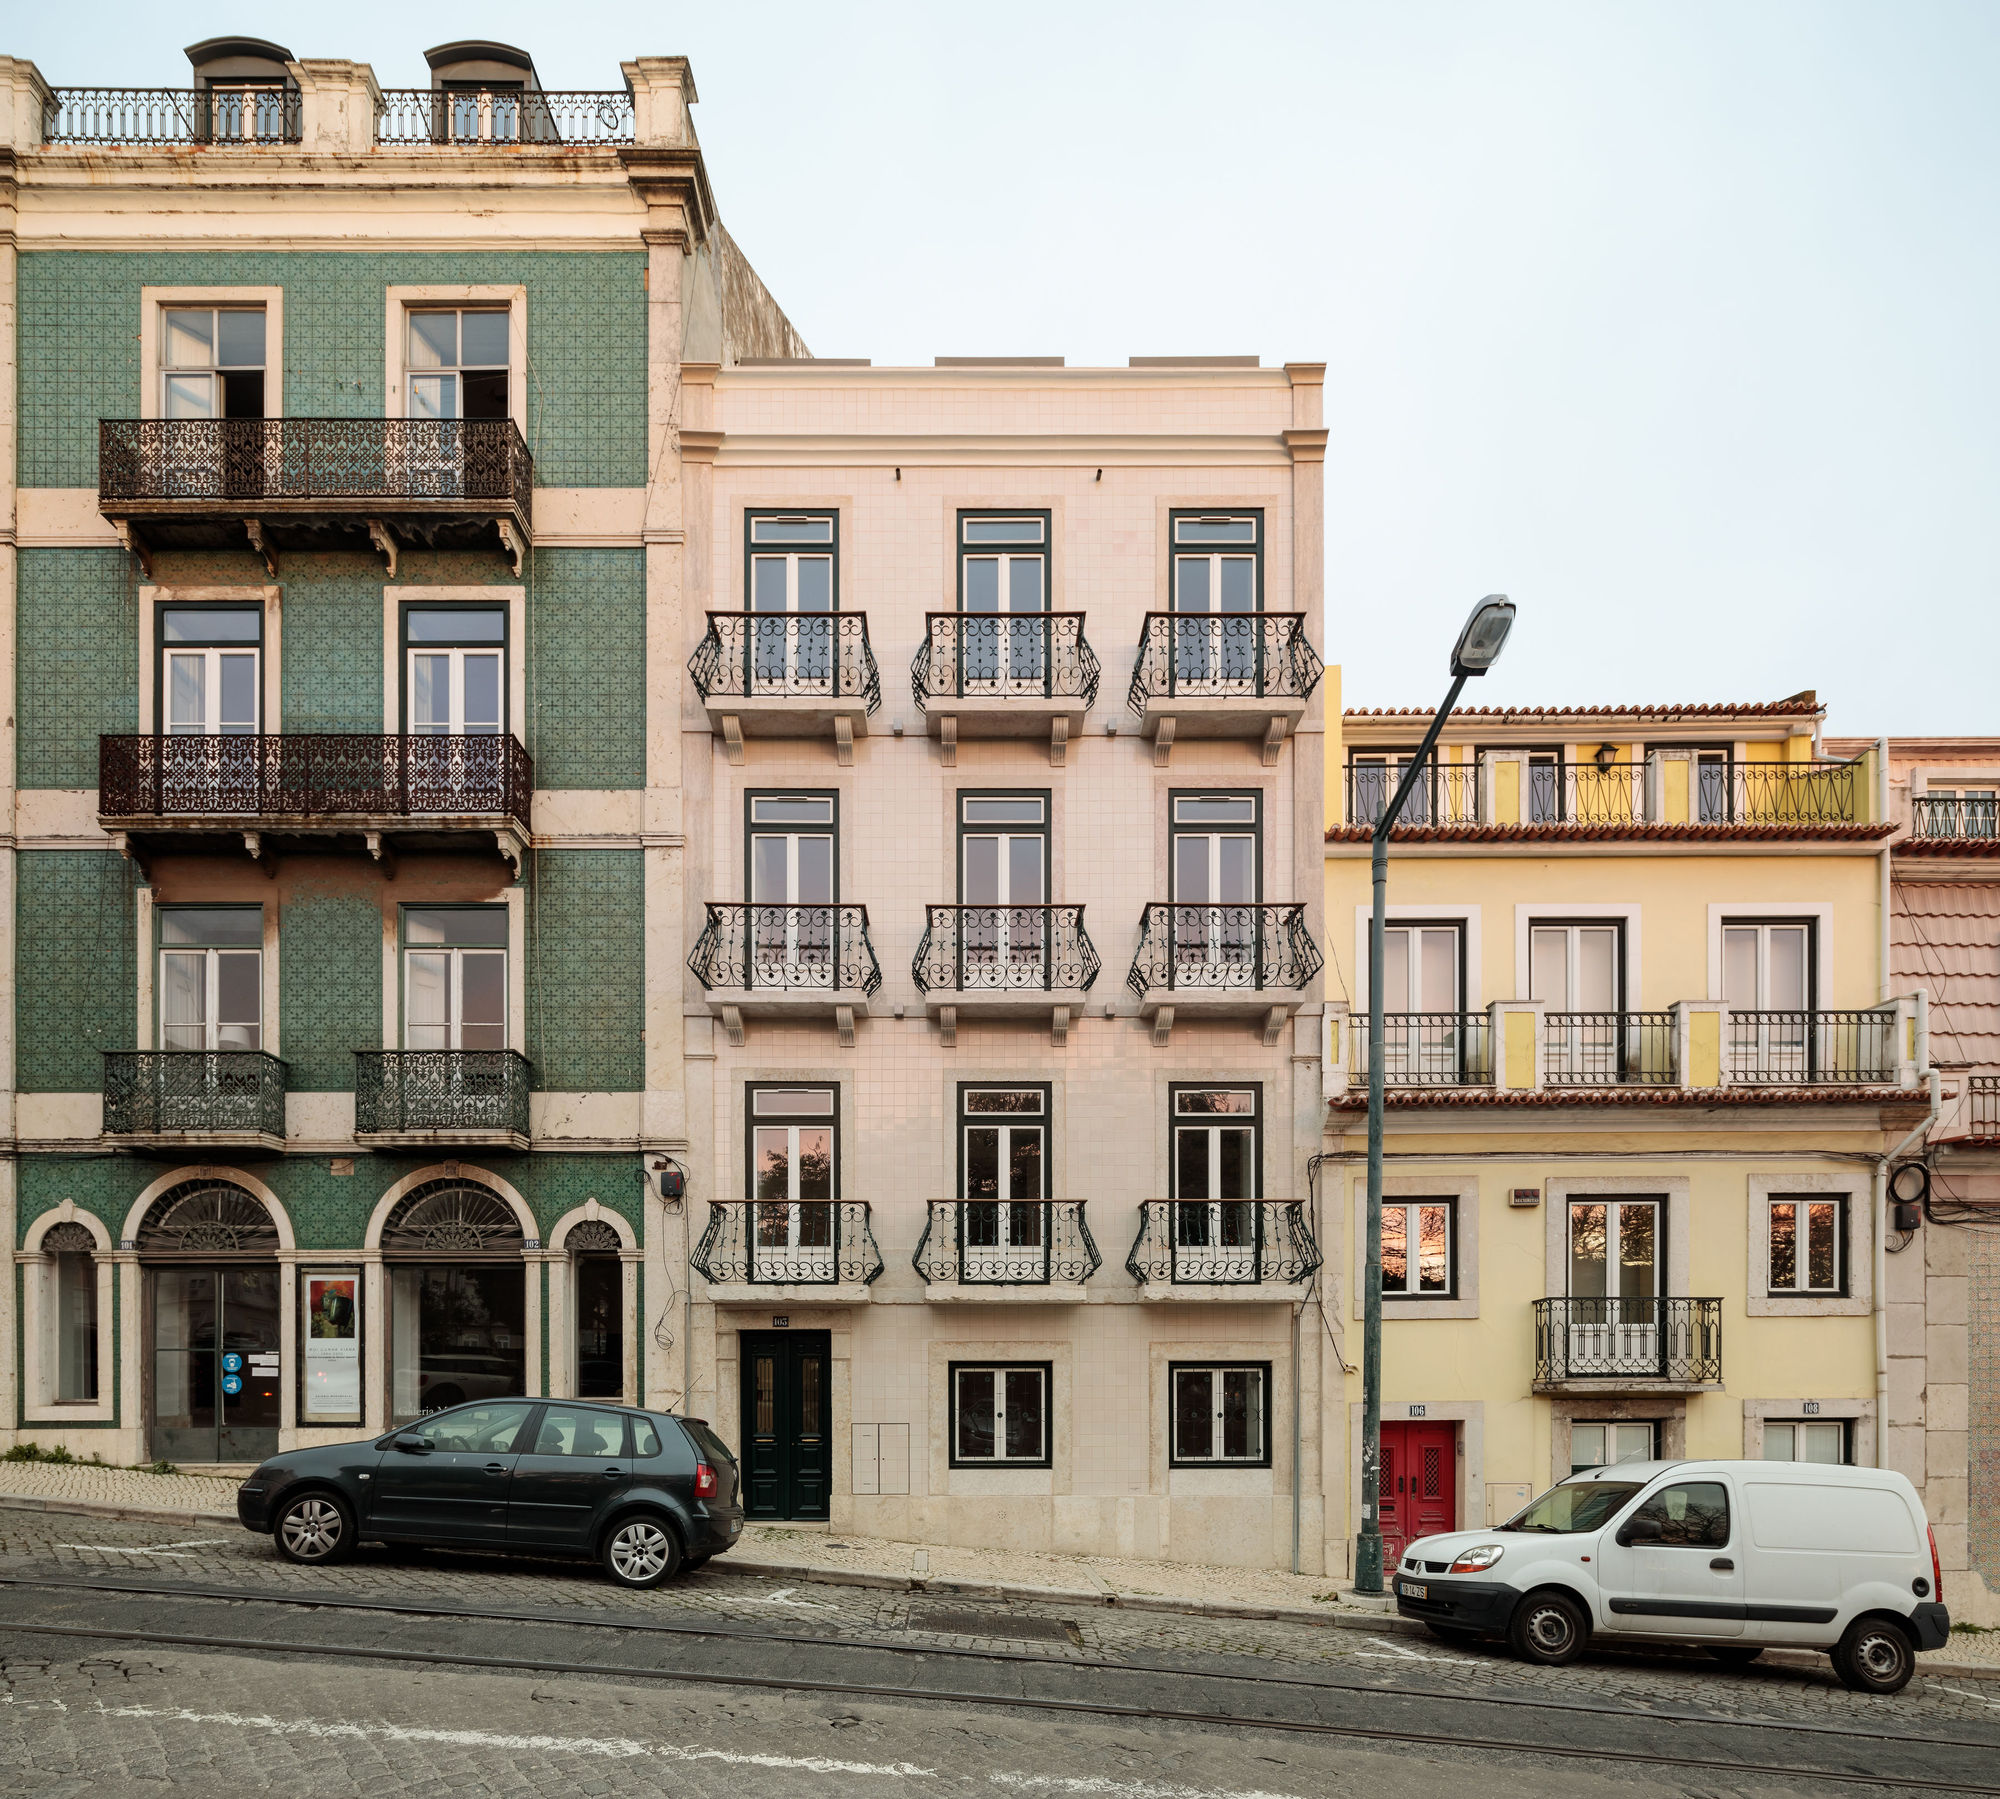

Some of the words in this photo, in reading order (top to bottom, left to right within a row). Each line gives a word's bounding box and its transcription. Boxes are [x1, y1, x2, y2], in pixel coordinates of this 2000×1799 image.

[121, 1241, 133, 1250] 101
[526, 1240, 539, 1249] 102
[398, 1406, 434, 1416] Galeria
[1411, 1406, 1424, 1416] 106
[1805, 1403, 1818, 1414] 108
